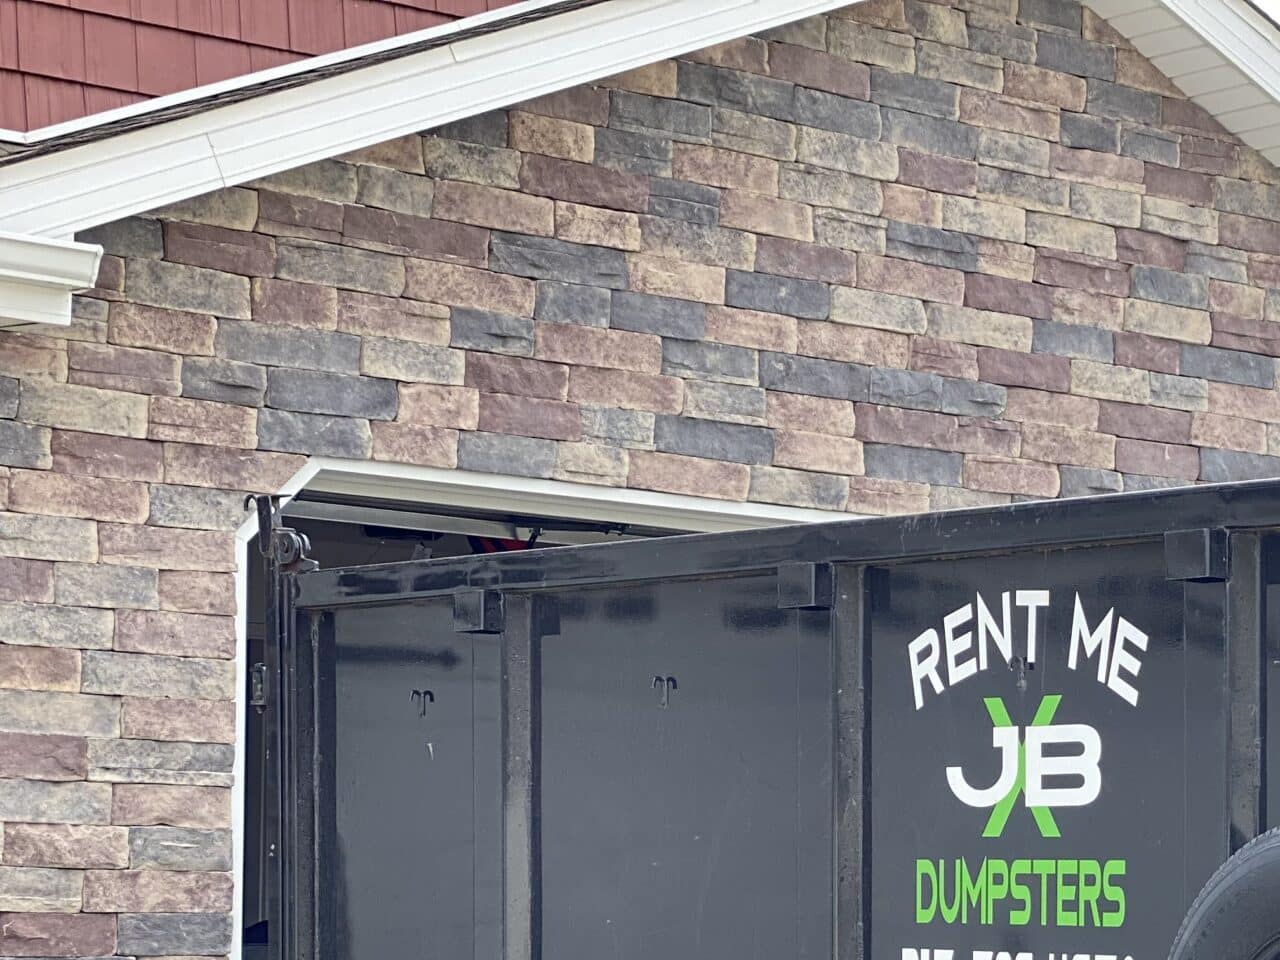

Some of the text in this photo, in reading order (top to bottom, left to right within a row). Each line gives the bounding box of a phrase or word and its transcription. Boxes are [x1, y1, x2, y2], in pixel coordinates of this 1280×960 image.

[908, 590, 1149, 711] RENT ME
[915, 855, 1126, 927] DUMPSTERS
